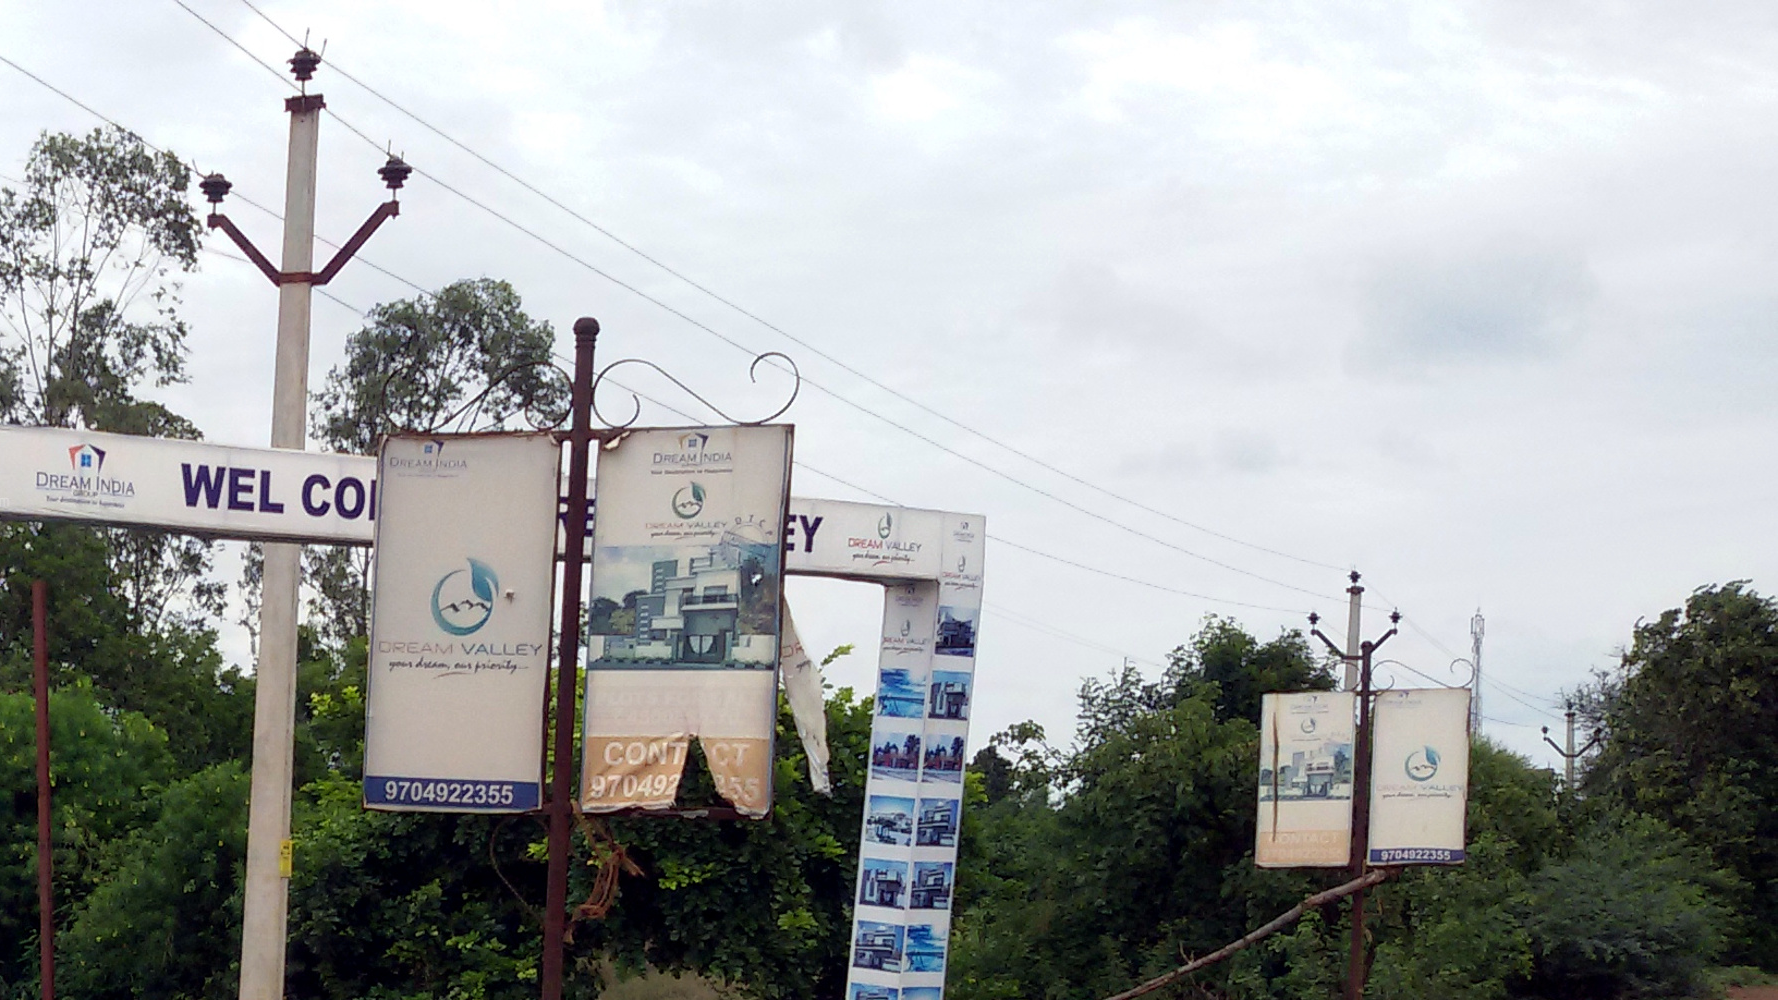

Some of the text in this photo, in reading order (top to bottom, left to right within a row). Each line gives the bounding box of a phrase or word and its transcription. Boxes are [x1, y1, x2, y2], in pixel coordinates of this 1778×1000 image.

[389, 456, 432, 468] DREAM
[652, 451, 733, 465] DREAM INDIA
[34, 471, 136, 496] DREAM INDIA
[181, 462, 377, 520] WEL CO
[847, 537, 922, 553] DREAM VALLEY
[378, 640, 544, 657] DREAM VALLEY
[603, 741, 751, 767] CONTCT
[385, 779, 514, 805] 9704922355
[590, 774, 760, 803] 970492355
[1381, 850, 1451, 861] 9704922355
